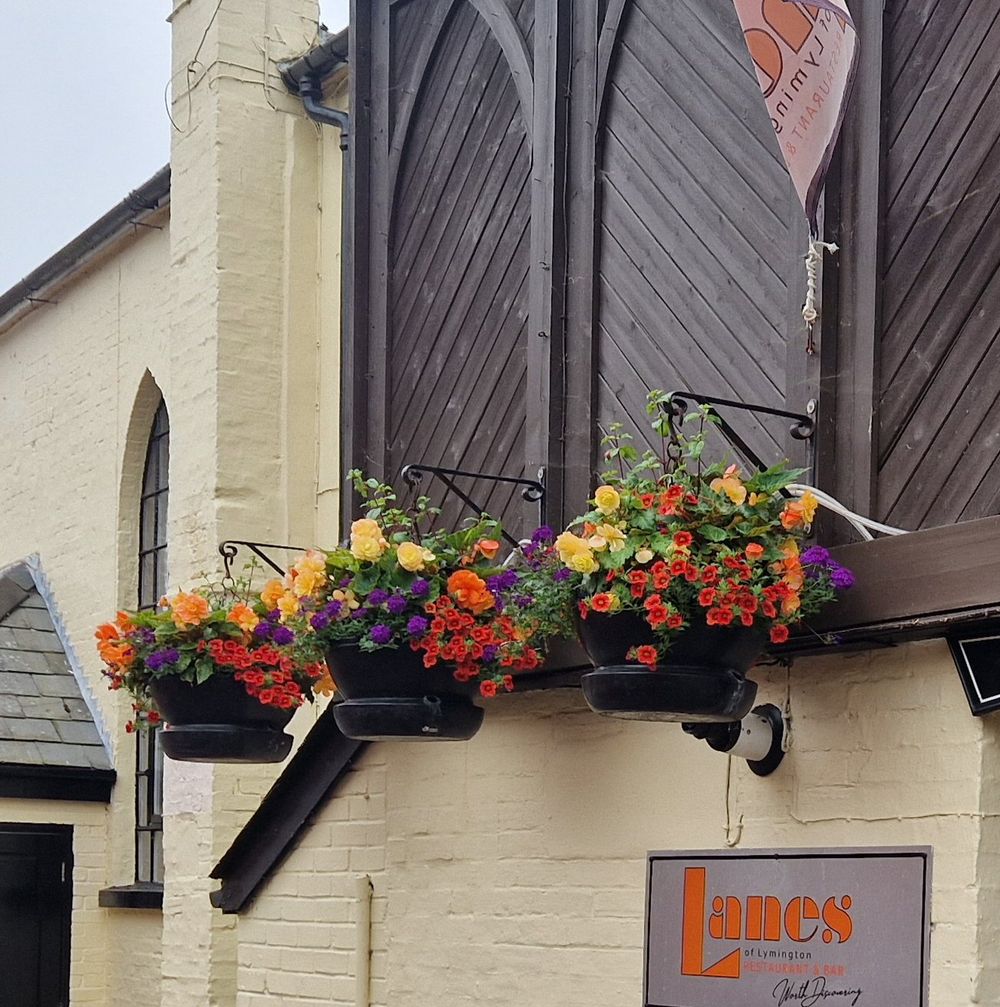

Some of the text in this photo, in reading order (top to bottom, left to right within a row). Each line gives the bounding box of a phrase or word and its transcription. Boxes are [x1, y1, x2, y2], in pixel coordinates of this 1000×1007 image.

[680, 866, 853, 979] Lanes
[744, 946, 812, 961] of Lymington
[743, 960, 809, 976] RESTAURANT
[823, 964, 846, 977] BAR
[772, 977, 808, 1007] Worth
